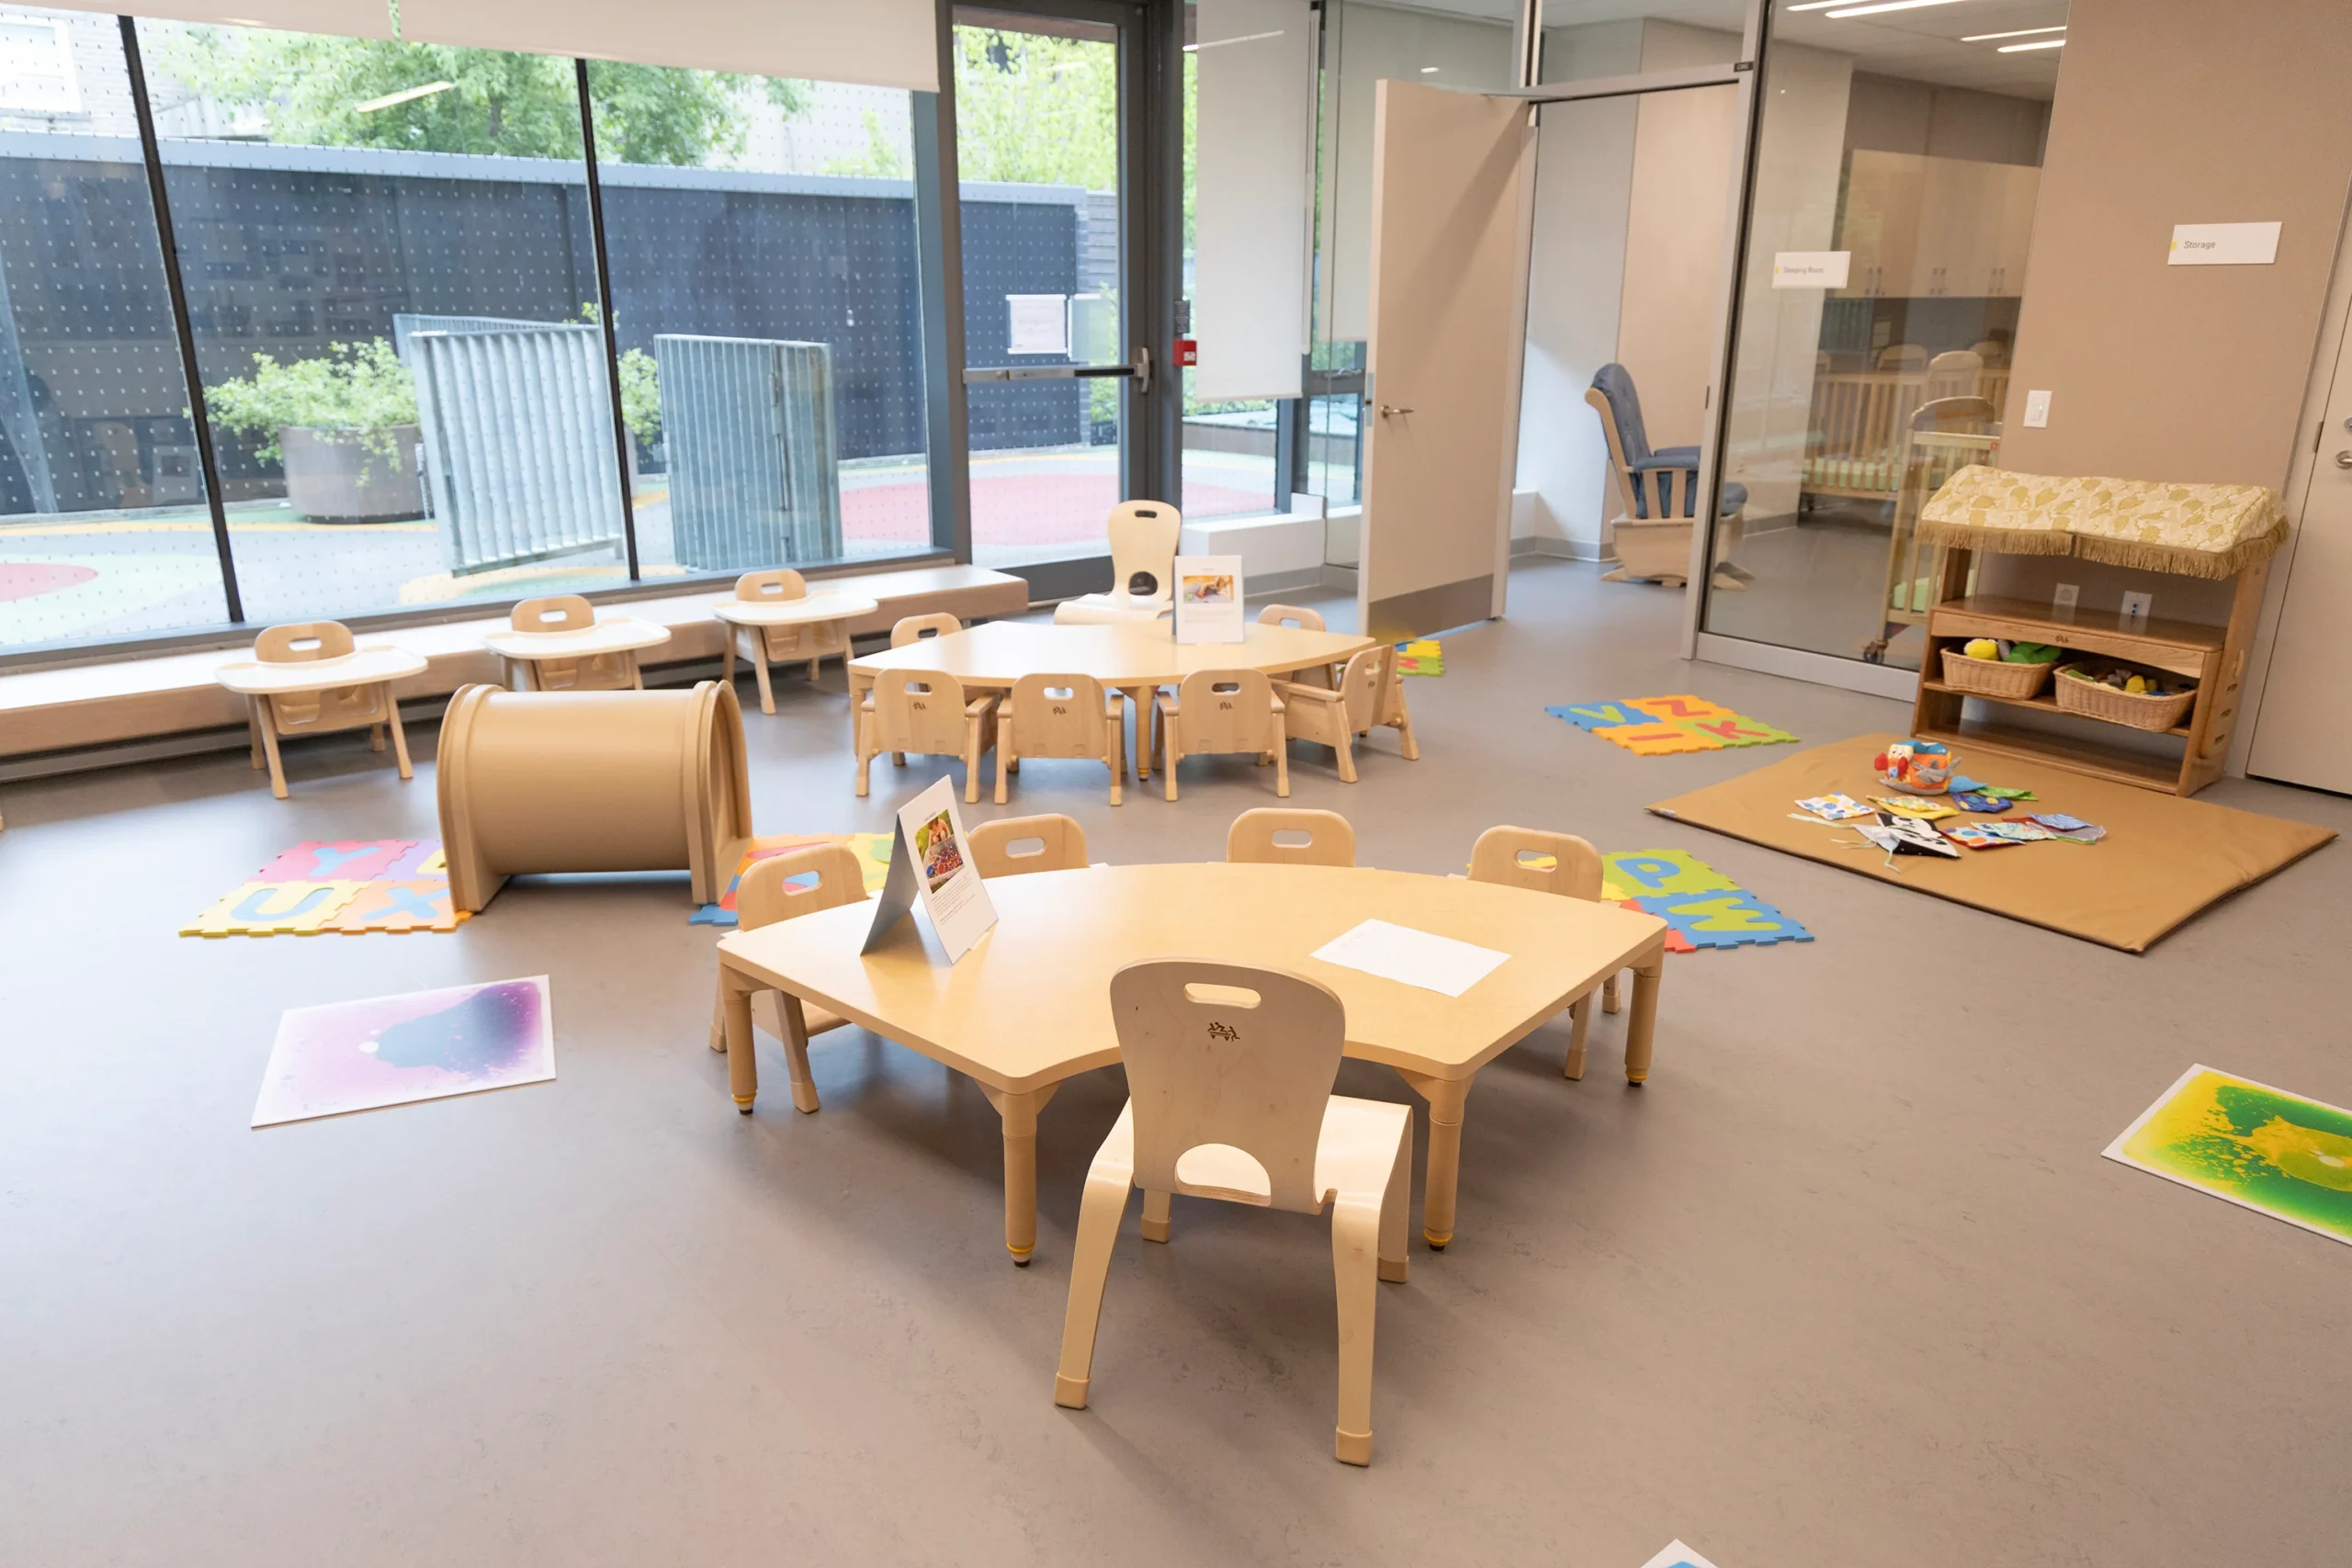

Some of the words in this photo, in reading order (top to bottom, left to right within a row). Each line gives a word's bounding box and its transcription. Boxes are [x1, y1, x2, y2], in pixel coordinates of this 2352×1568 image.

[2184, 241, 2216, 250] Storage
[1696, 721, 1770, 739] K
[309, 847, 381, 876] Y
[1614, 857, 1680, 888] P
[230, 887, 334, 921] U
[359, 886, 450, 920] X
